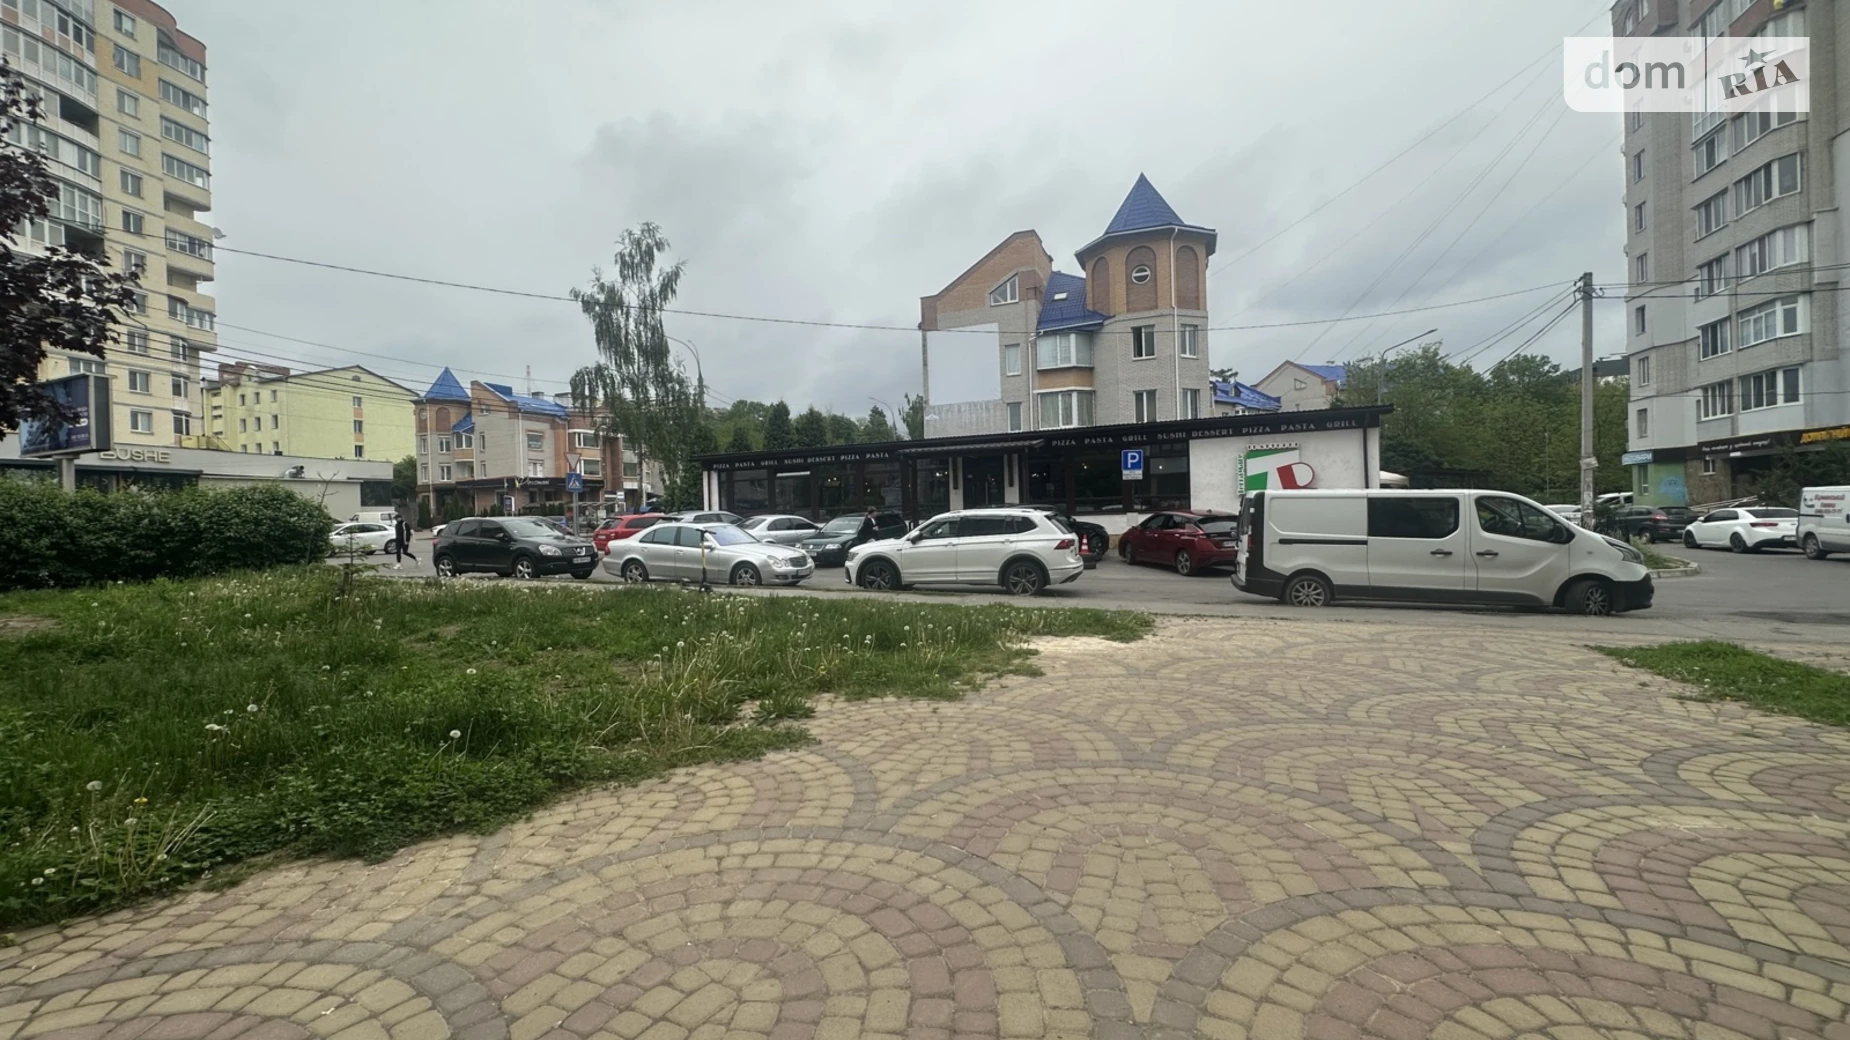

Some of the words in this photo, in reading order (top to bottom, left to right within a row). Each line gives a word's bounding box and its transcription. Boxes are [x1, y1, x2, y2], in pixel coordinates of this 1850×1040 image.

[1051, 439, 1076, 447] PIZZA
[1084, 437, 1114, 445] PASTA
[1122, 434, 1148, 442] GRILL
[1157, 431, 1186, 439] SUSHI
[1191, 428, 1234, 438] DESSERT
[1242, 426, 1271, 435] PIZZA
[1280, 422, 1316, 431] PASTA
[1326, 419, 1358, 428] GRILL
[1127, 452, 1140, 468] P
